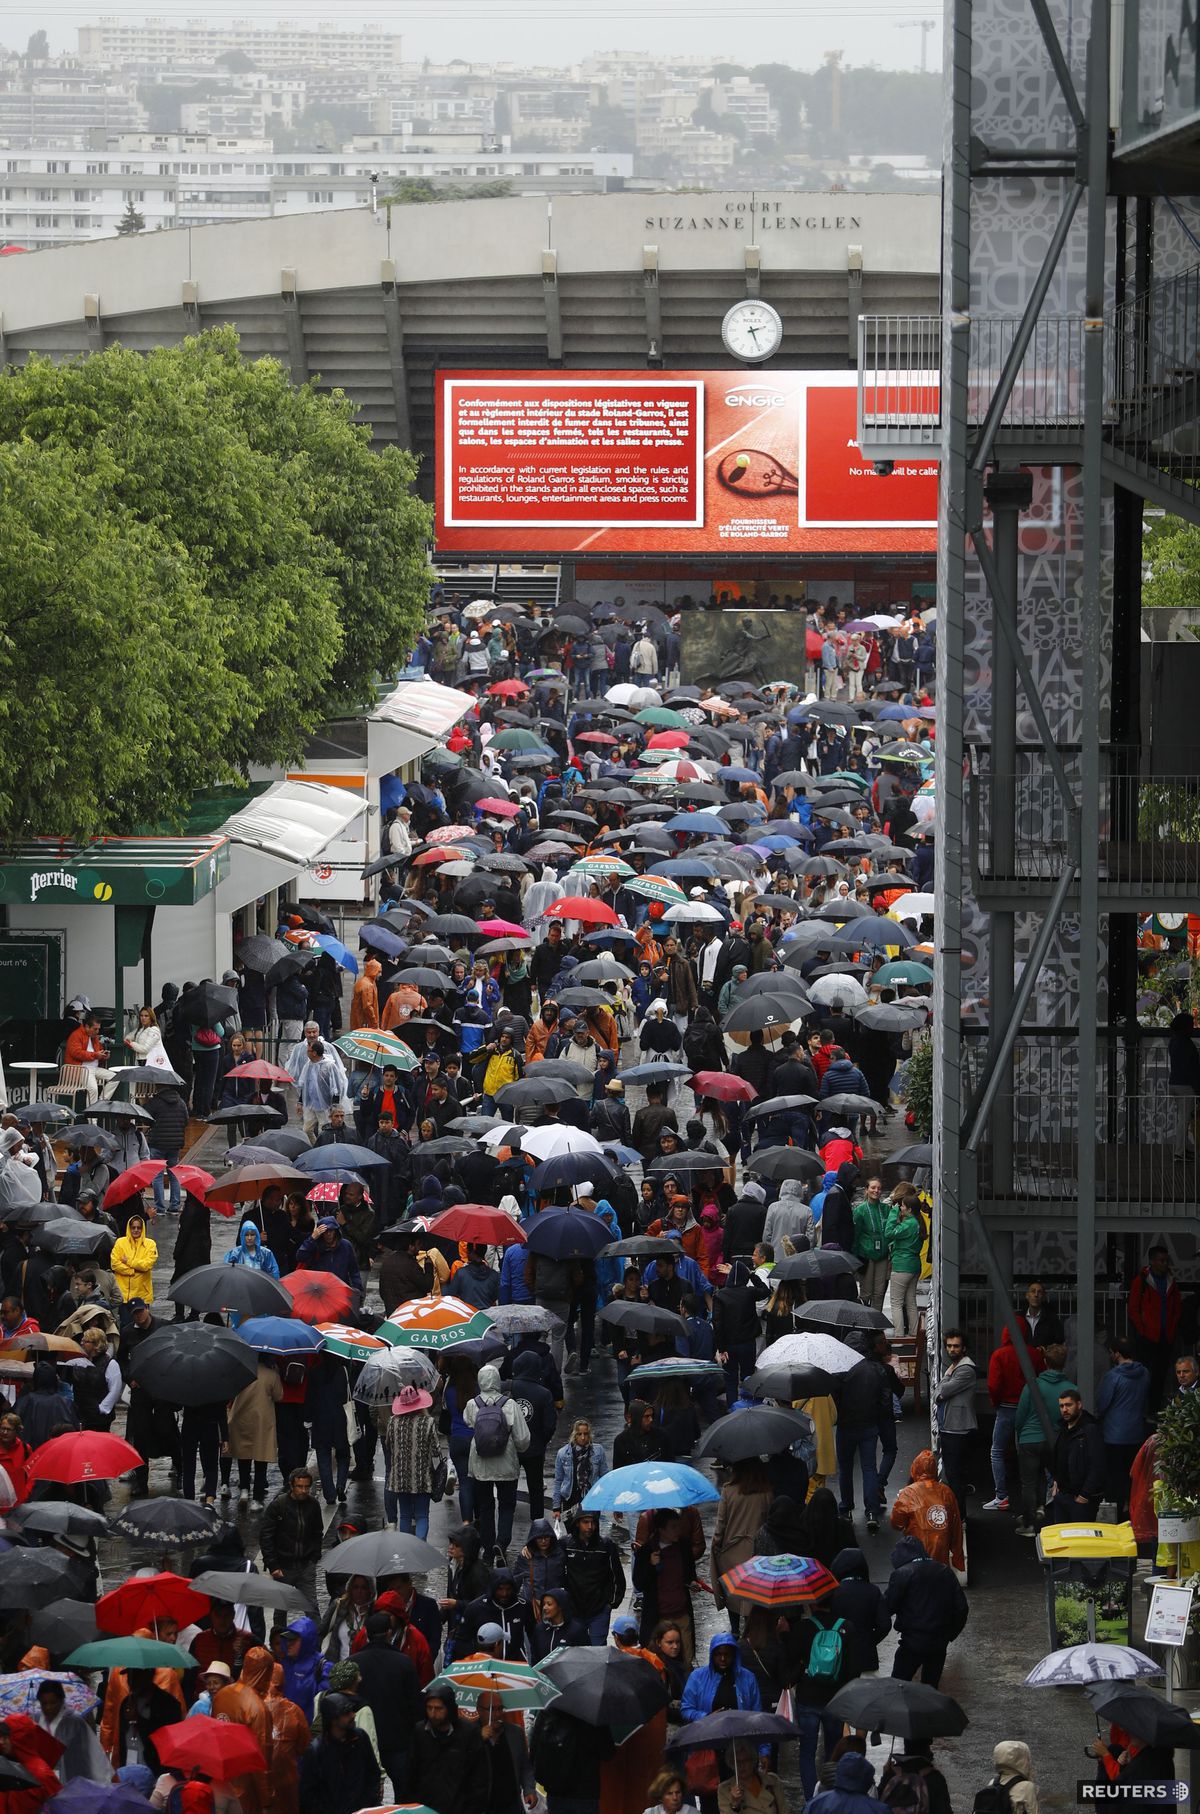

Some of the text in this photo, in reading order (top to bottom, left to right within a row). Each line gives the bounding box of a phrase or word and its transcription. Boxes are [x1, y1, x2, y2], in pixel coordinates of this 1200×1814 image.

[725, 202, 782, 213] COURT
[645, 216, 864, 230] SUZANNE LENGLEN
[459, 399, 522, 407] Conformément
[542, 399, 591, 409] dispositions
[595, 399, 641, 409] législatives
[657, 399, 689, 409] vigueur
[482, 409, 524, 418] règlement
[458, 418, 515, 426] formellement
[518, 418, 549, 426] interdit
[552, 418, 562, 426] de
[565, 418, 589, 426] fumer
[593, 418, 612, 426] dans
[615, 418, 626, 426] les
[669, 418, 688, 426] ainsi
[491, 437, 501, 445] les
[505, 439, 536, 447] espaces
[592, 437, 599, 445] et
[603, 437, 614, 445] les
[617, 437, 640, 445] salles
[643, 437, 652, 445] de
[459, 465, 688, 475] In accordance with current legislation and the rules and
[849, 467, 862, 476] No
[906, 467, 917, 476] be
[919, 467, 938, 476] calle
[459, 475, 502, 484] regulations
[616, 475, 649, 484] smoking
[662, 475, 688, 484] strictly
[459, 484, 498, 494] prohibited
[501, 484, 507, 492] in
[510, 484, 523, 492] the
[526, 484, 550, 492] stands
[553, 484, 567, 492] and
[570, 484, 576, 492] in
[579, 484, 588, 492] all
[591, 484, 626, 492] enclosed
[660, 484, 677, 492] such
[542, 493, 597, 502] entertainment
[623, 493, 637, 502] and
[640, 495, 659, 504] press
[410, 1328, 467, 1344] GARROS
[452, 1662, 484, 1672] PARIS
